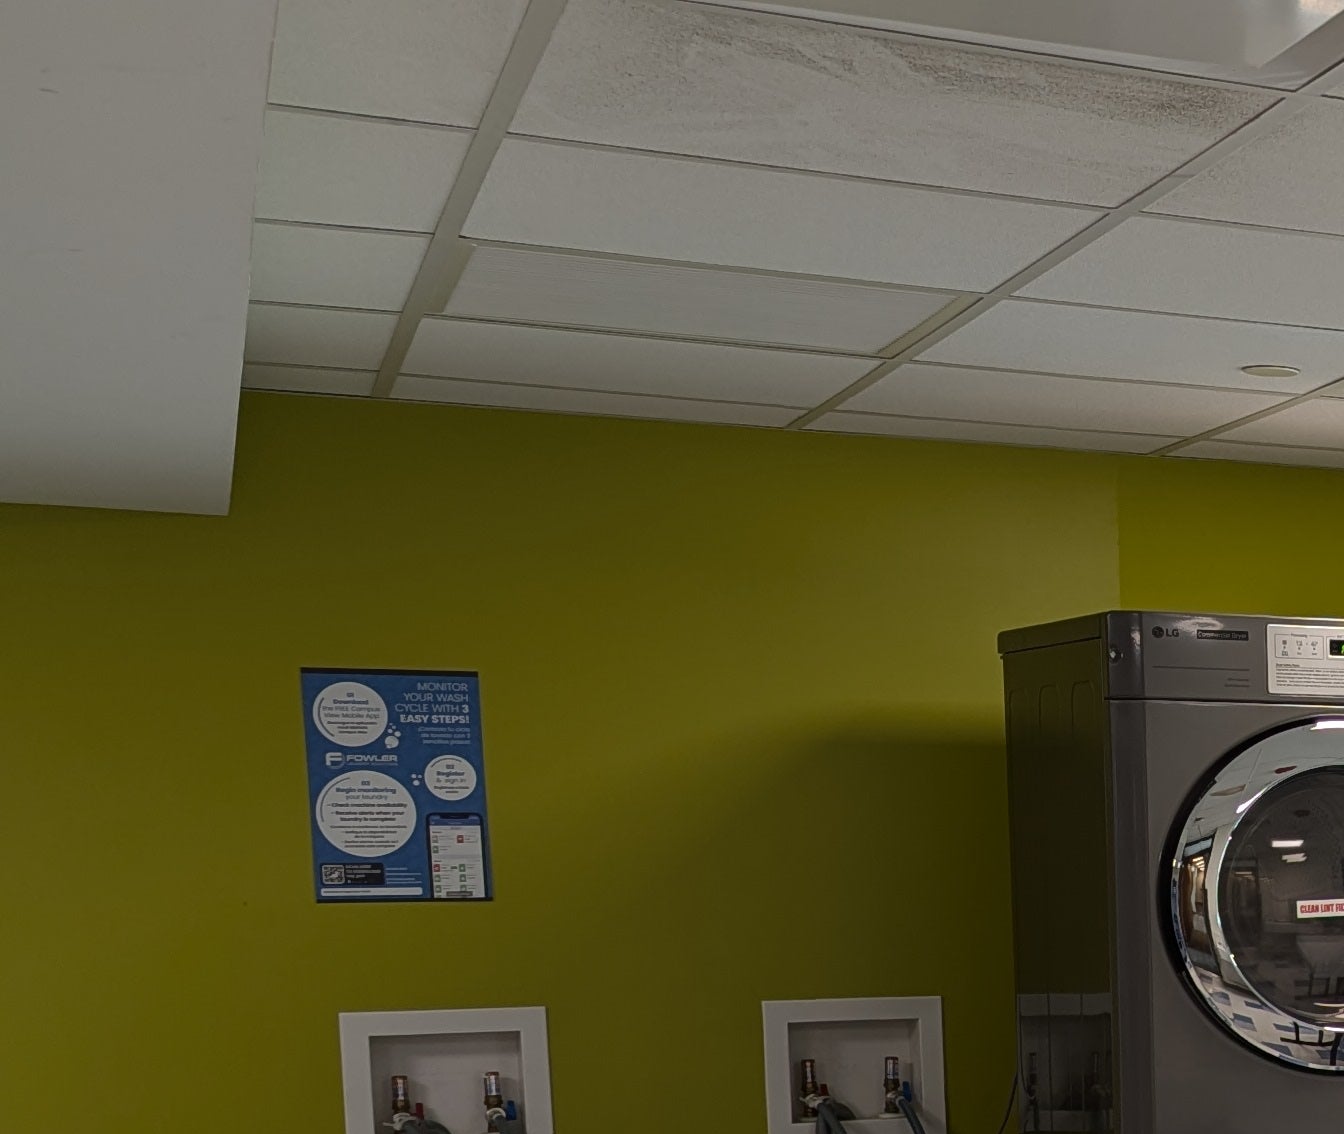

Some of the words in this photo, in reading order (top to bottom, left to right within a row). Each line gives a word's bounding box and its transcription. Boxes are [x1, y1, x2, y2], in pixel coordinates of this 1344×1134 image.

[1165, 629, 1180, 638] LG
[417, 682, 468, 692] MONITOR
[403, 693, 434, 702] YOUR
[436, 693, 469, 702] WASH
[394, 704, 430, 713] CYCLE
[432, 704, 460, 713] WITH
[462, 704, 470, 714] 3
[400, 715, 429, 723] EASY
[431, 715, 470, 724] STEPS!
[1300, 905, 1320, 914] CLEAN
[1321, 904, 1335, 913] LINT
